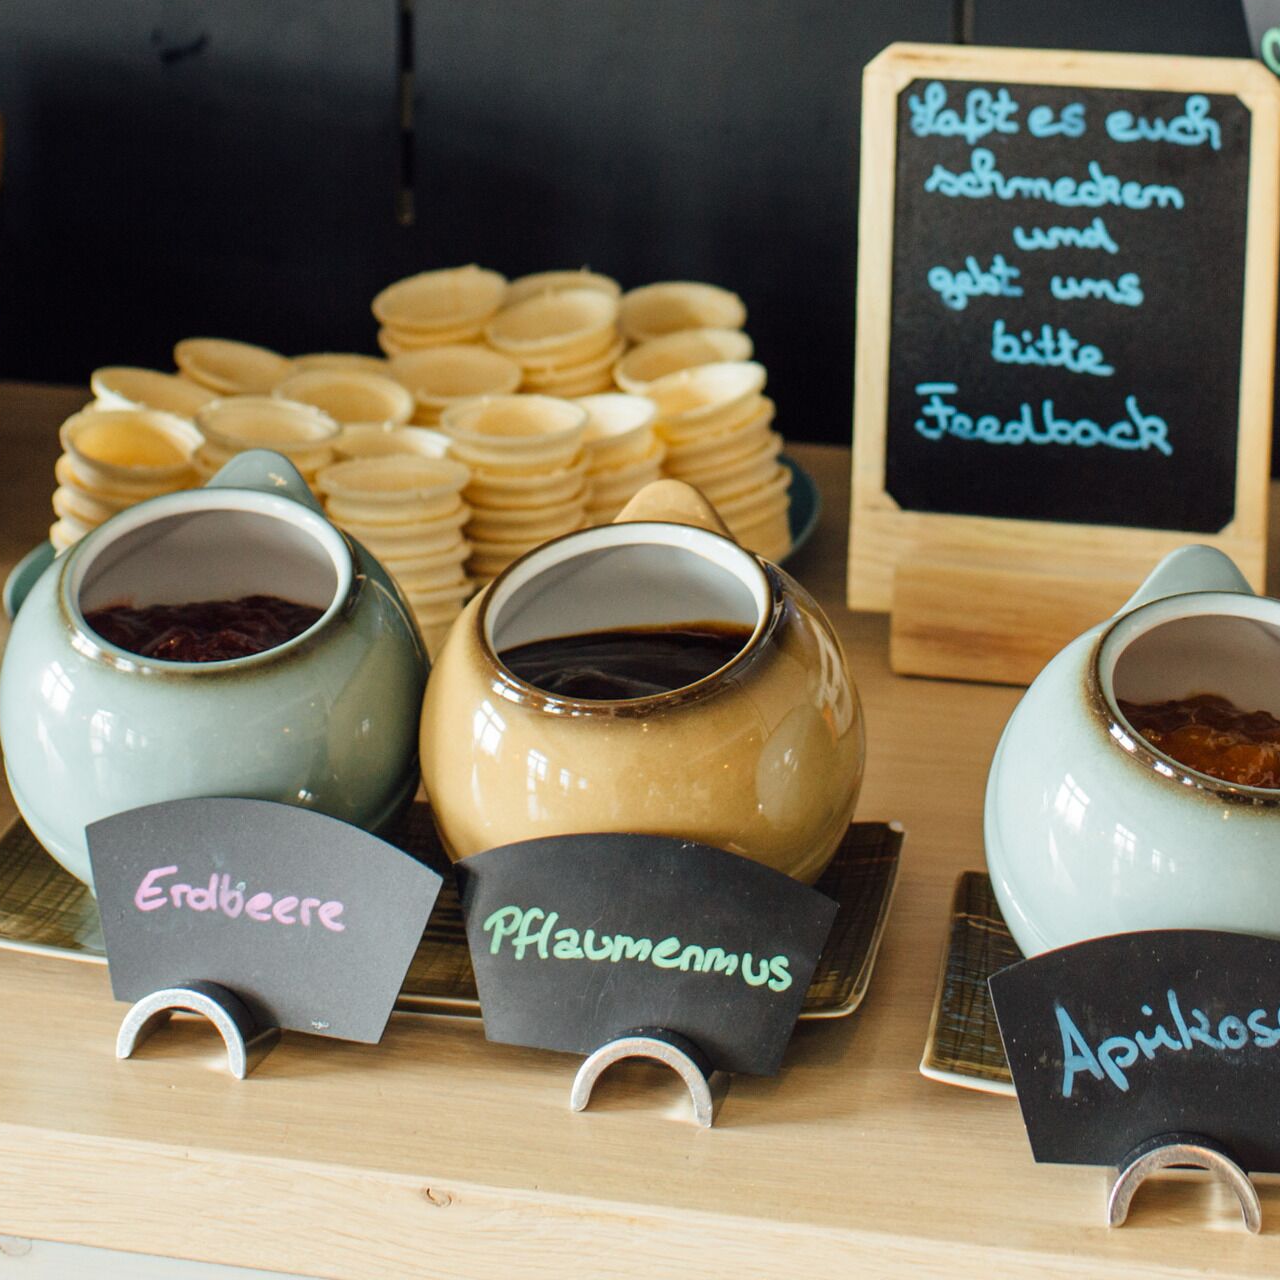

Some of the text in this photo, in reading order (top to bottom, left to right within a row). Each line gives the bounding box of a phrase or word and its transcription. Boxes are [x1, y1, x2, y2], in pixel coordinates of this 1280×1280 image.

[1027, 103, 1087, 138] es
[1105, 94, 1222, 151] euch
[924, 148, 1184, 210] schmecken
[1013, 216, 1119, 254] und
[927, 254, 1144, 311] gebt uns
[990, 318, 1115, 376] bitte
[914, 382, 1173, 456] Feedback
[134, 866, 344, 931] Erdbeere
[483, 904, 792, 992] Pflaumenmus
